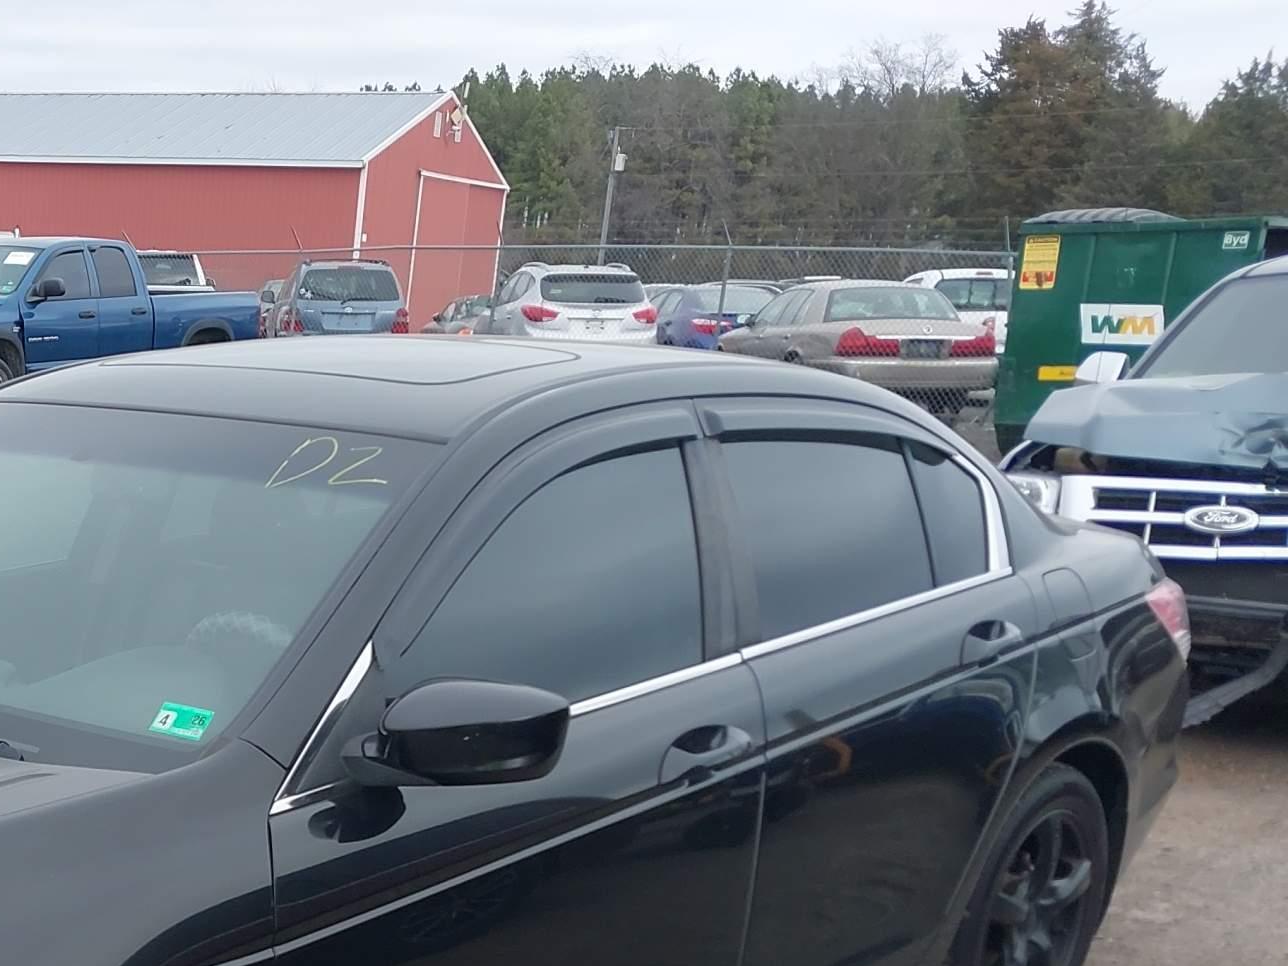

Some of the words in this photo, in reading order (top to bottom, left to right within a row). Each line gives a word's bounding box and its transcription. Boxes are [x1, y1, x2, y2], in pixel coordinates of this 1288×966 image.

[1091, 315, 1155, 335] WM
[1203, 503, 1239, 523] Ford
[158, 713, 170, 727] 4
